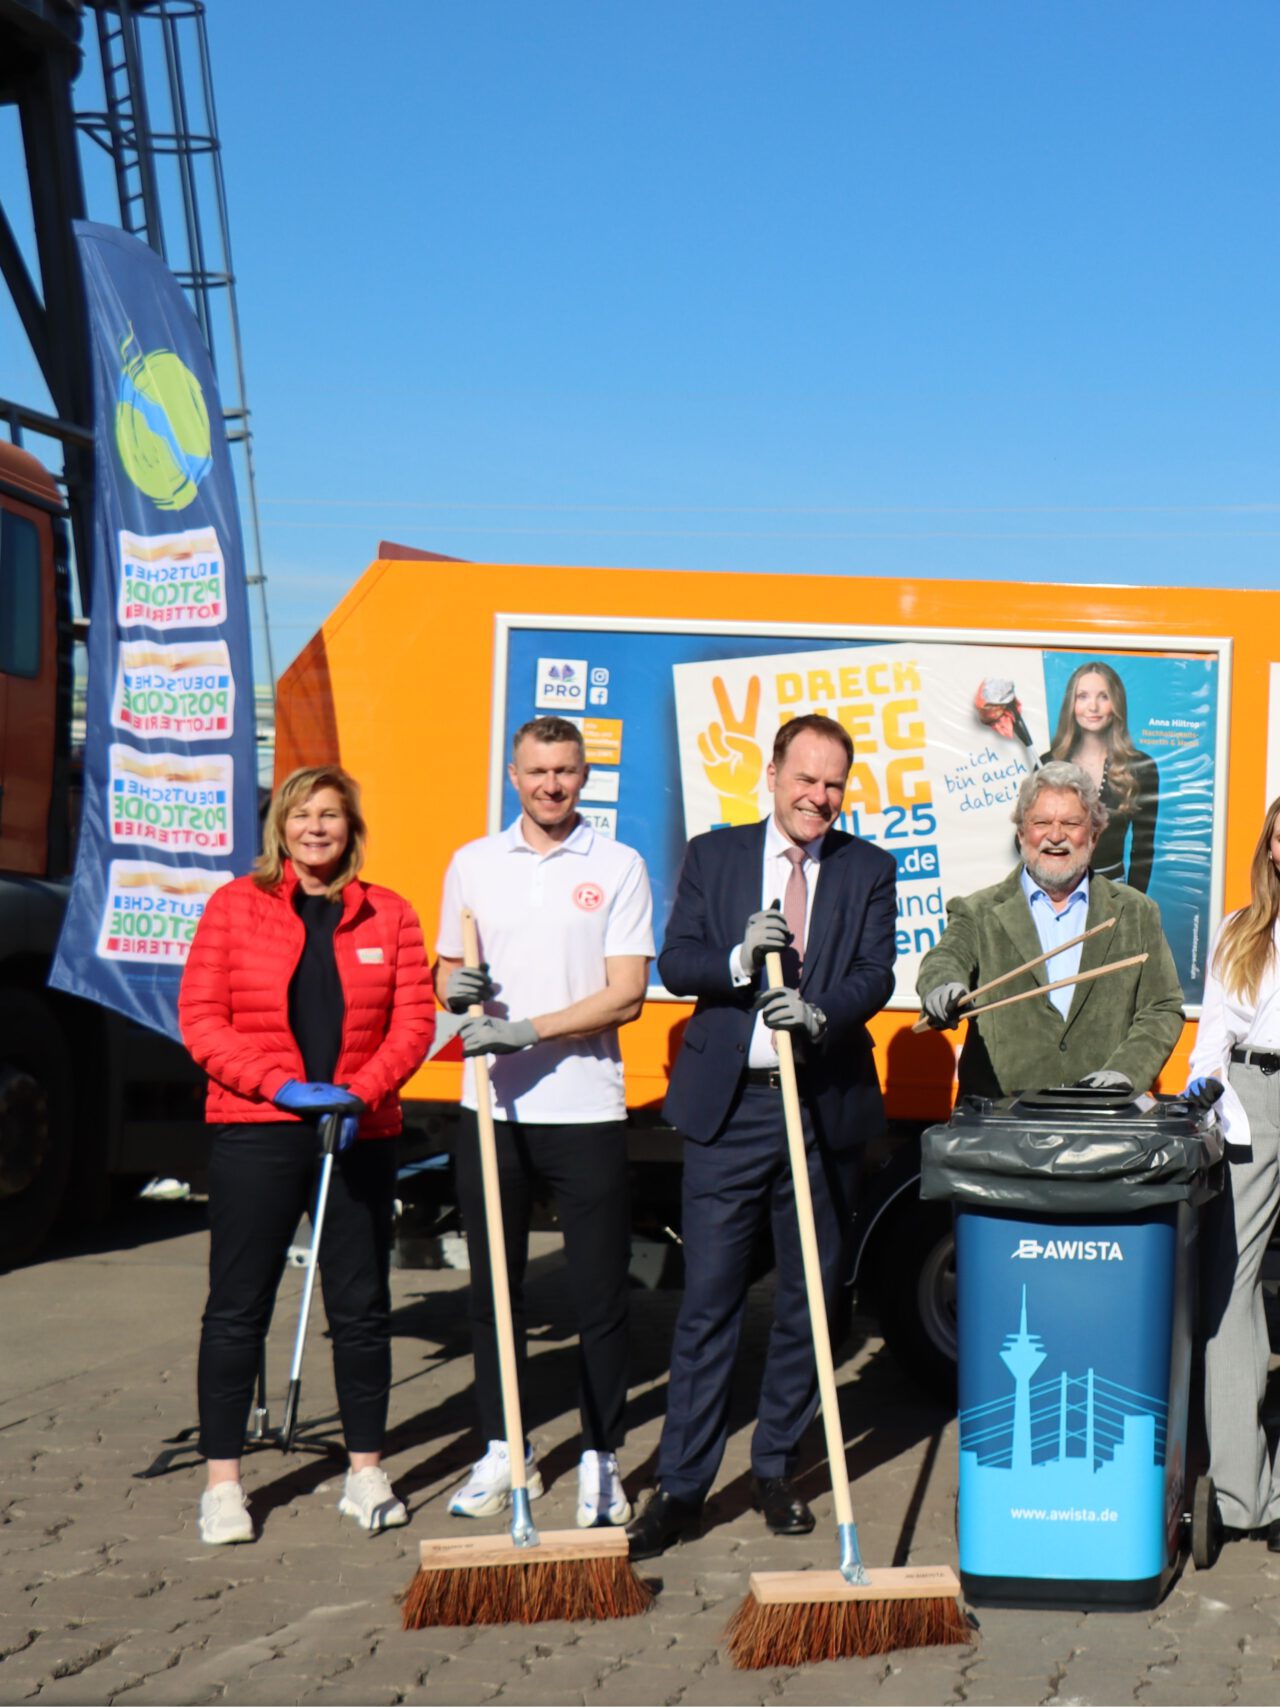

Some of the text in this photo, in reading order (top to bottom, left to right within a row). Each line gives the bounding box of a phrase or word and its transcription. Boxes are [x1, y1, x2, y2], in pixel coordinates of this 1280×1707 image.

[544, 684, 581, 698] PRO
[775, 660, 922, 705] DRECK
[842, 756, 932, 816] AG
[944, 759, 1027, 793] bin auch
[960, 781, 1019, 811] dabei!
[882, 802, 937, 840] 25
[1043, 1240, 1124, 1261] AWISTA
[1010, 1507, 1118, 1521] www.awista.de
